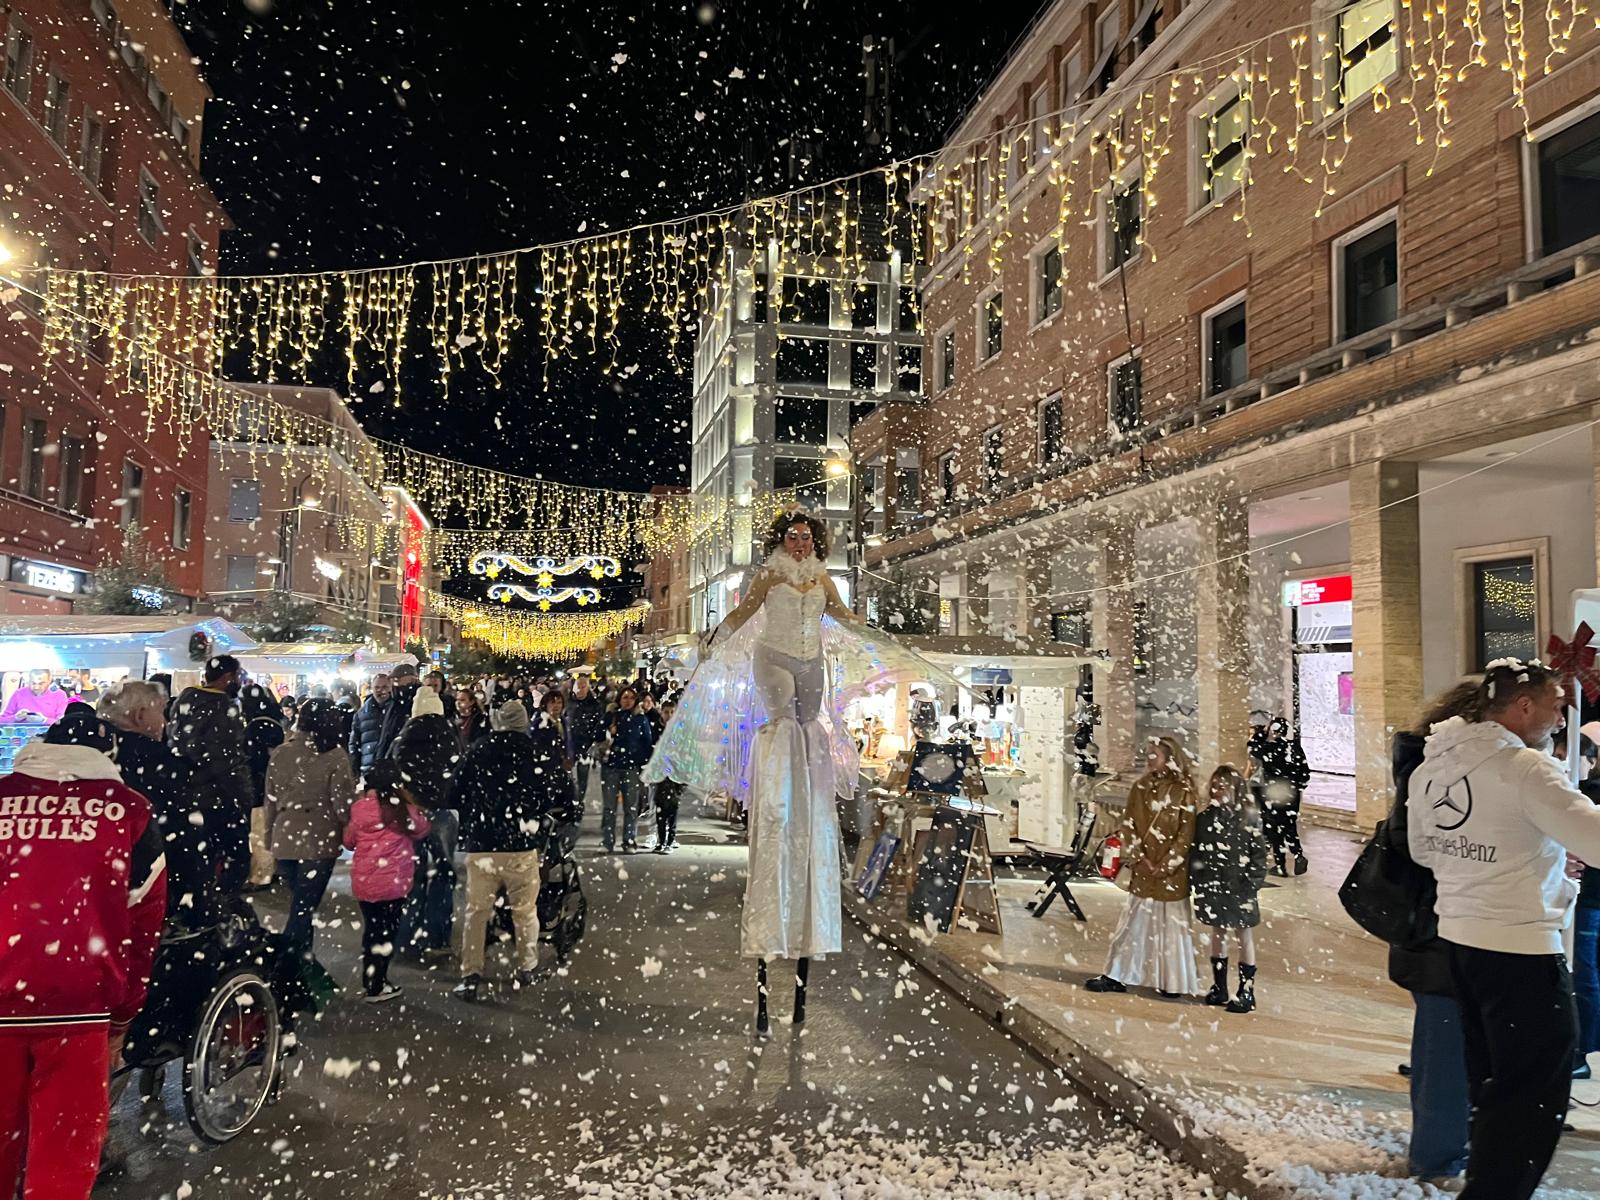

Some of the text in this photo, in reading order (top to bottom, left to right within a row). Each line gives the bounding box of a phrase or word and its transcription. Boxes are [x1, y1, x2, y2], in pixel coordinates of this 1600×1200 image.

[27, 565, 75, 594] TEZES
[0, 796, 125, 821] HICAGO
[0, 818, 98, 841] BULLS
